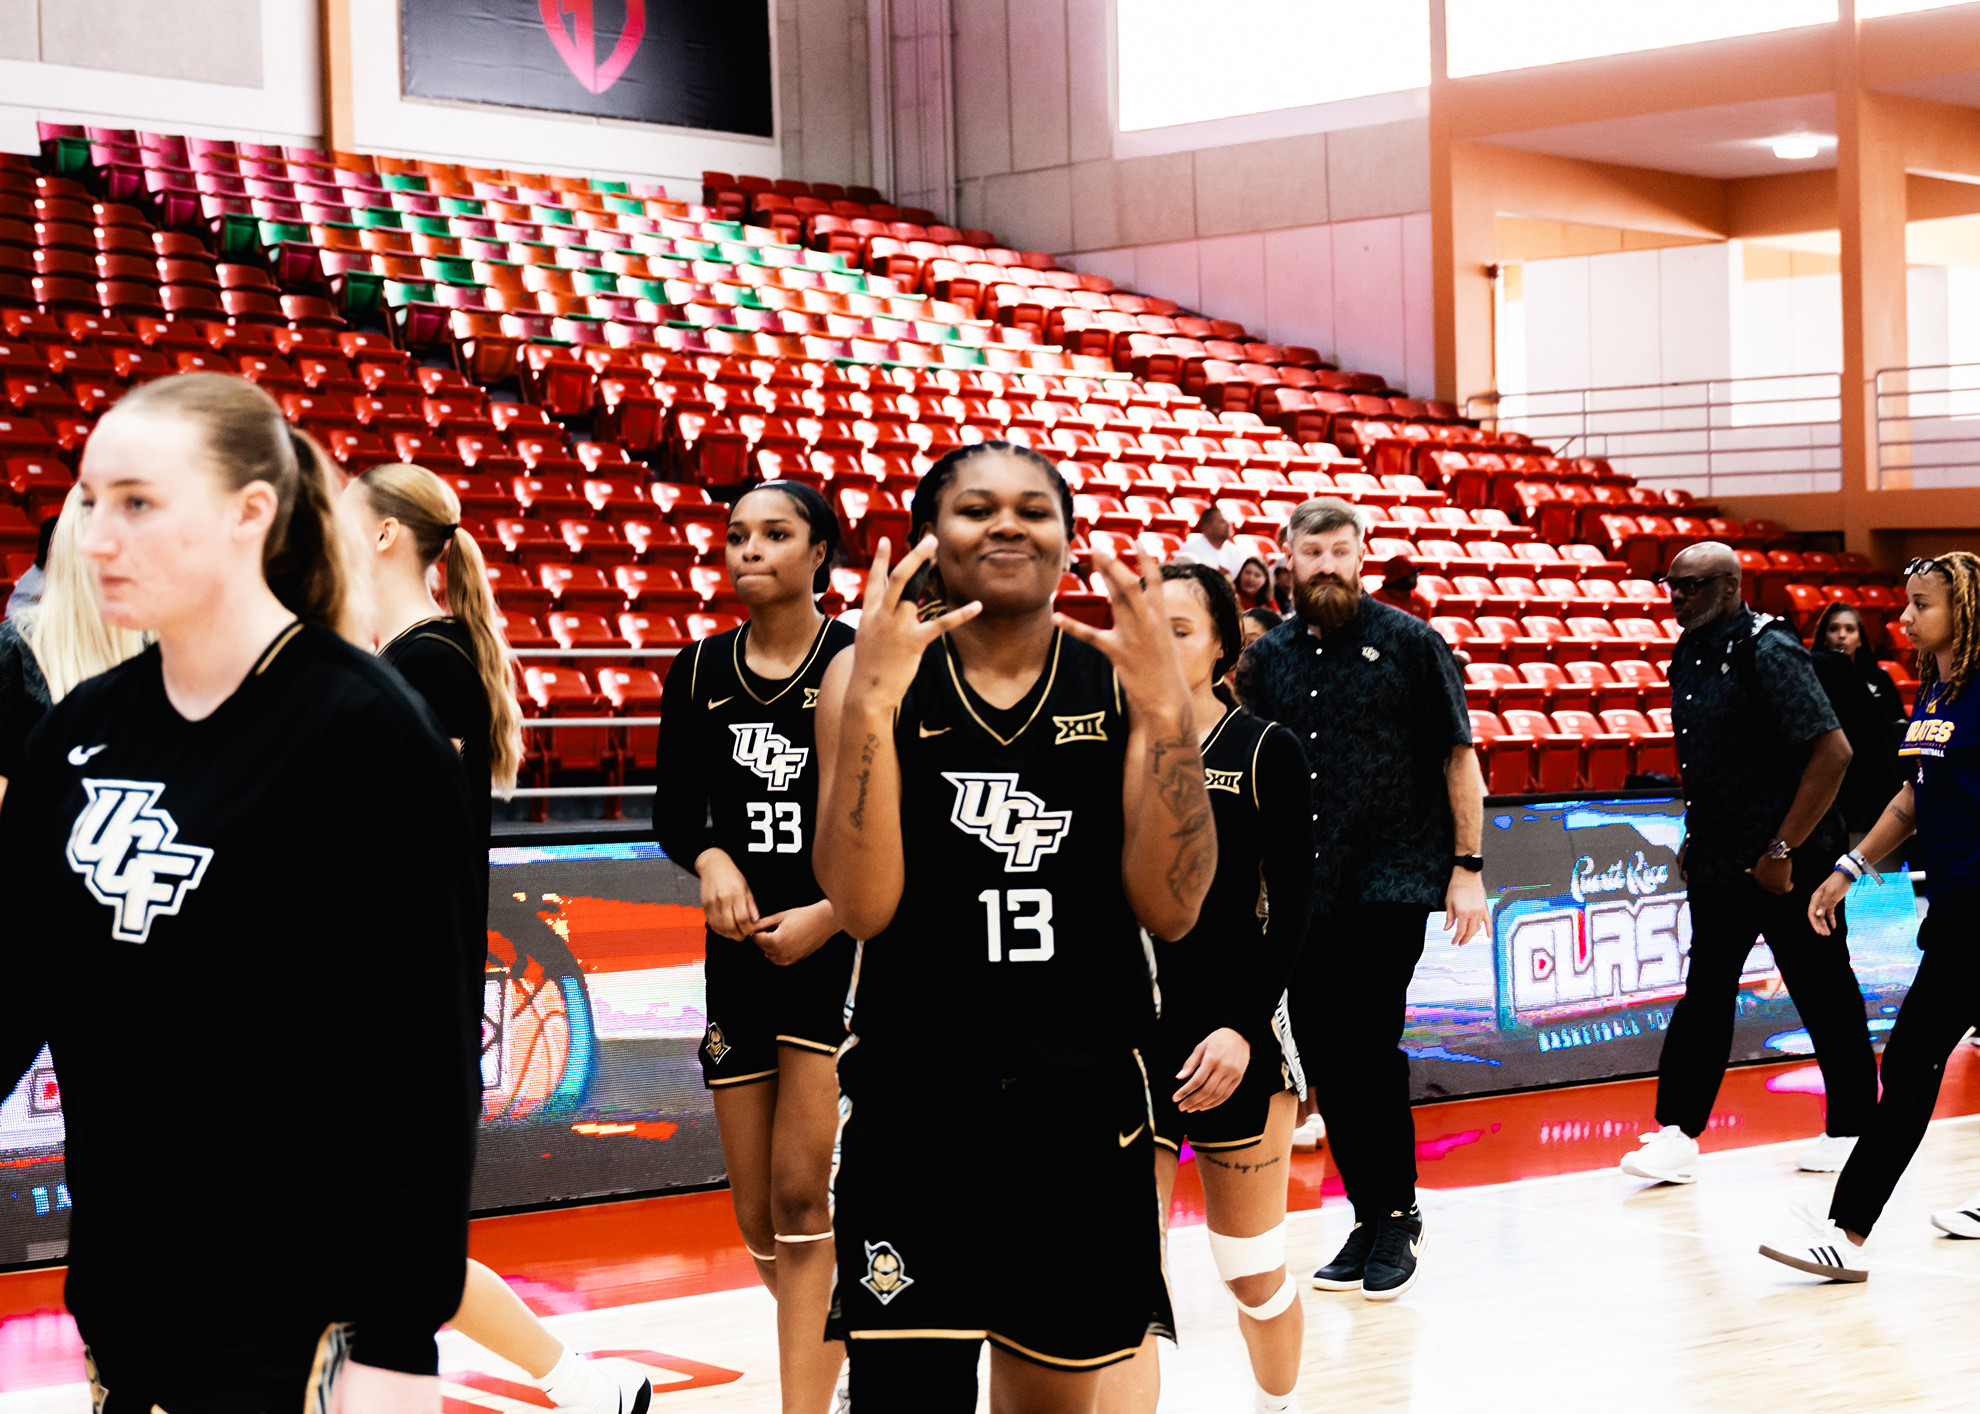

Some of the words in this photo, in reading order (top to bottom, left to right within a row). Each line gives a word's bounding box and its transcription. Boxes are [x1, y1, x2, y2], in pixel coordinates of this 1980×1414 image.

[728, 722, 809, 791] UCF
[746, 802, 802, 853] 33
[940, 771, 1072, 873] UCF
[66, 777, 214, 944] UCF
[978, 888, 1054, 962] 13
